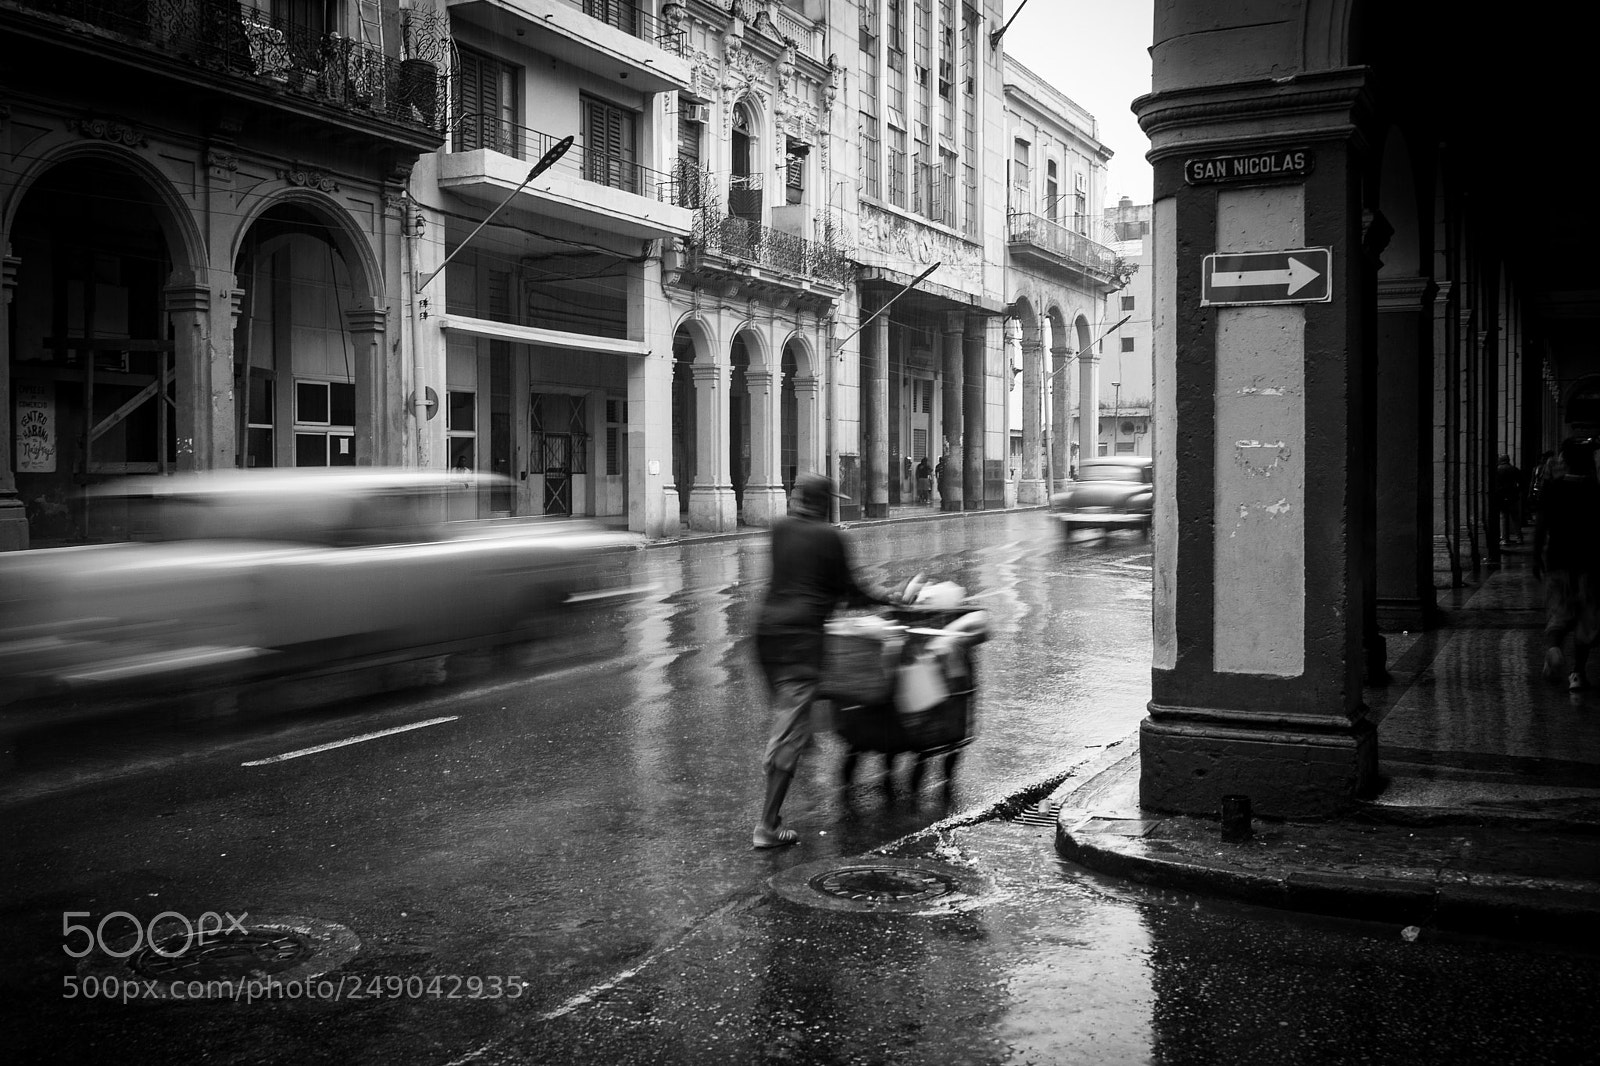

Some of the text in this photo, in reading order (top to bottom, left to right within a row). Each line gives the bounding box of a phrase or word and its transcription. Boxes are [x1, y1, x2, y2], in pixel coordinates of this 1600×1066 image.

[1193, 152, 1305, 179] SAN NICOLAS
[21, 410, 48, 427] CENTRO
